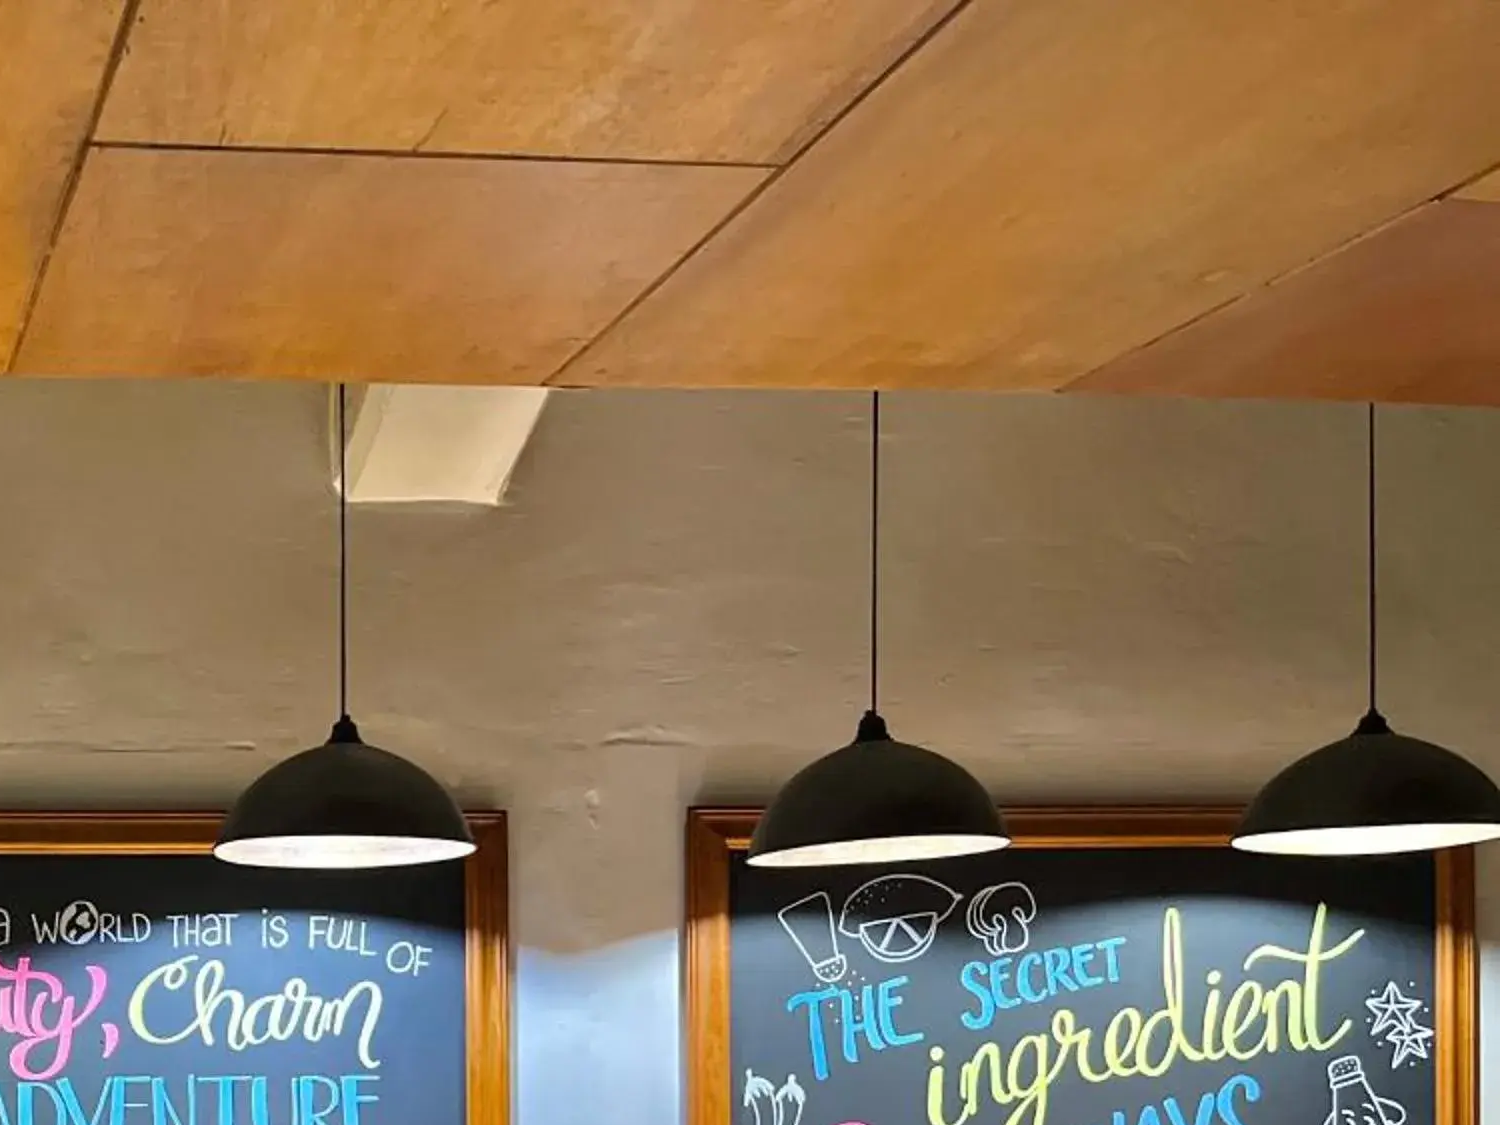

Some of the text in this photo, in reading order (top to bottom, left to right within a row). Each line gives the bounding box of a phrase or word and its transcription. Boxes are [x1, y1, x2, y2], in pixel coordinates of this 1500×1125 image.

[308, 914, 377, 957] FULL
[386, 941, 434, 977] OF
[128, 954, 384, 1069] Charm
[786, 935, 1128, 1082] THE SECRET
